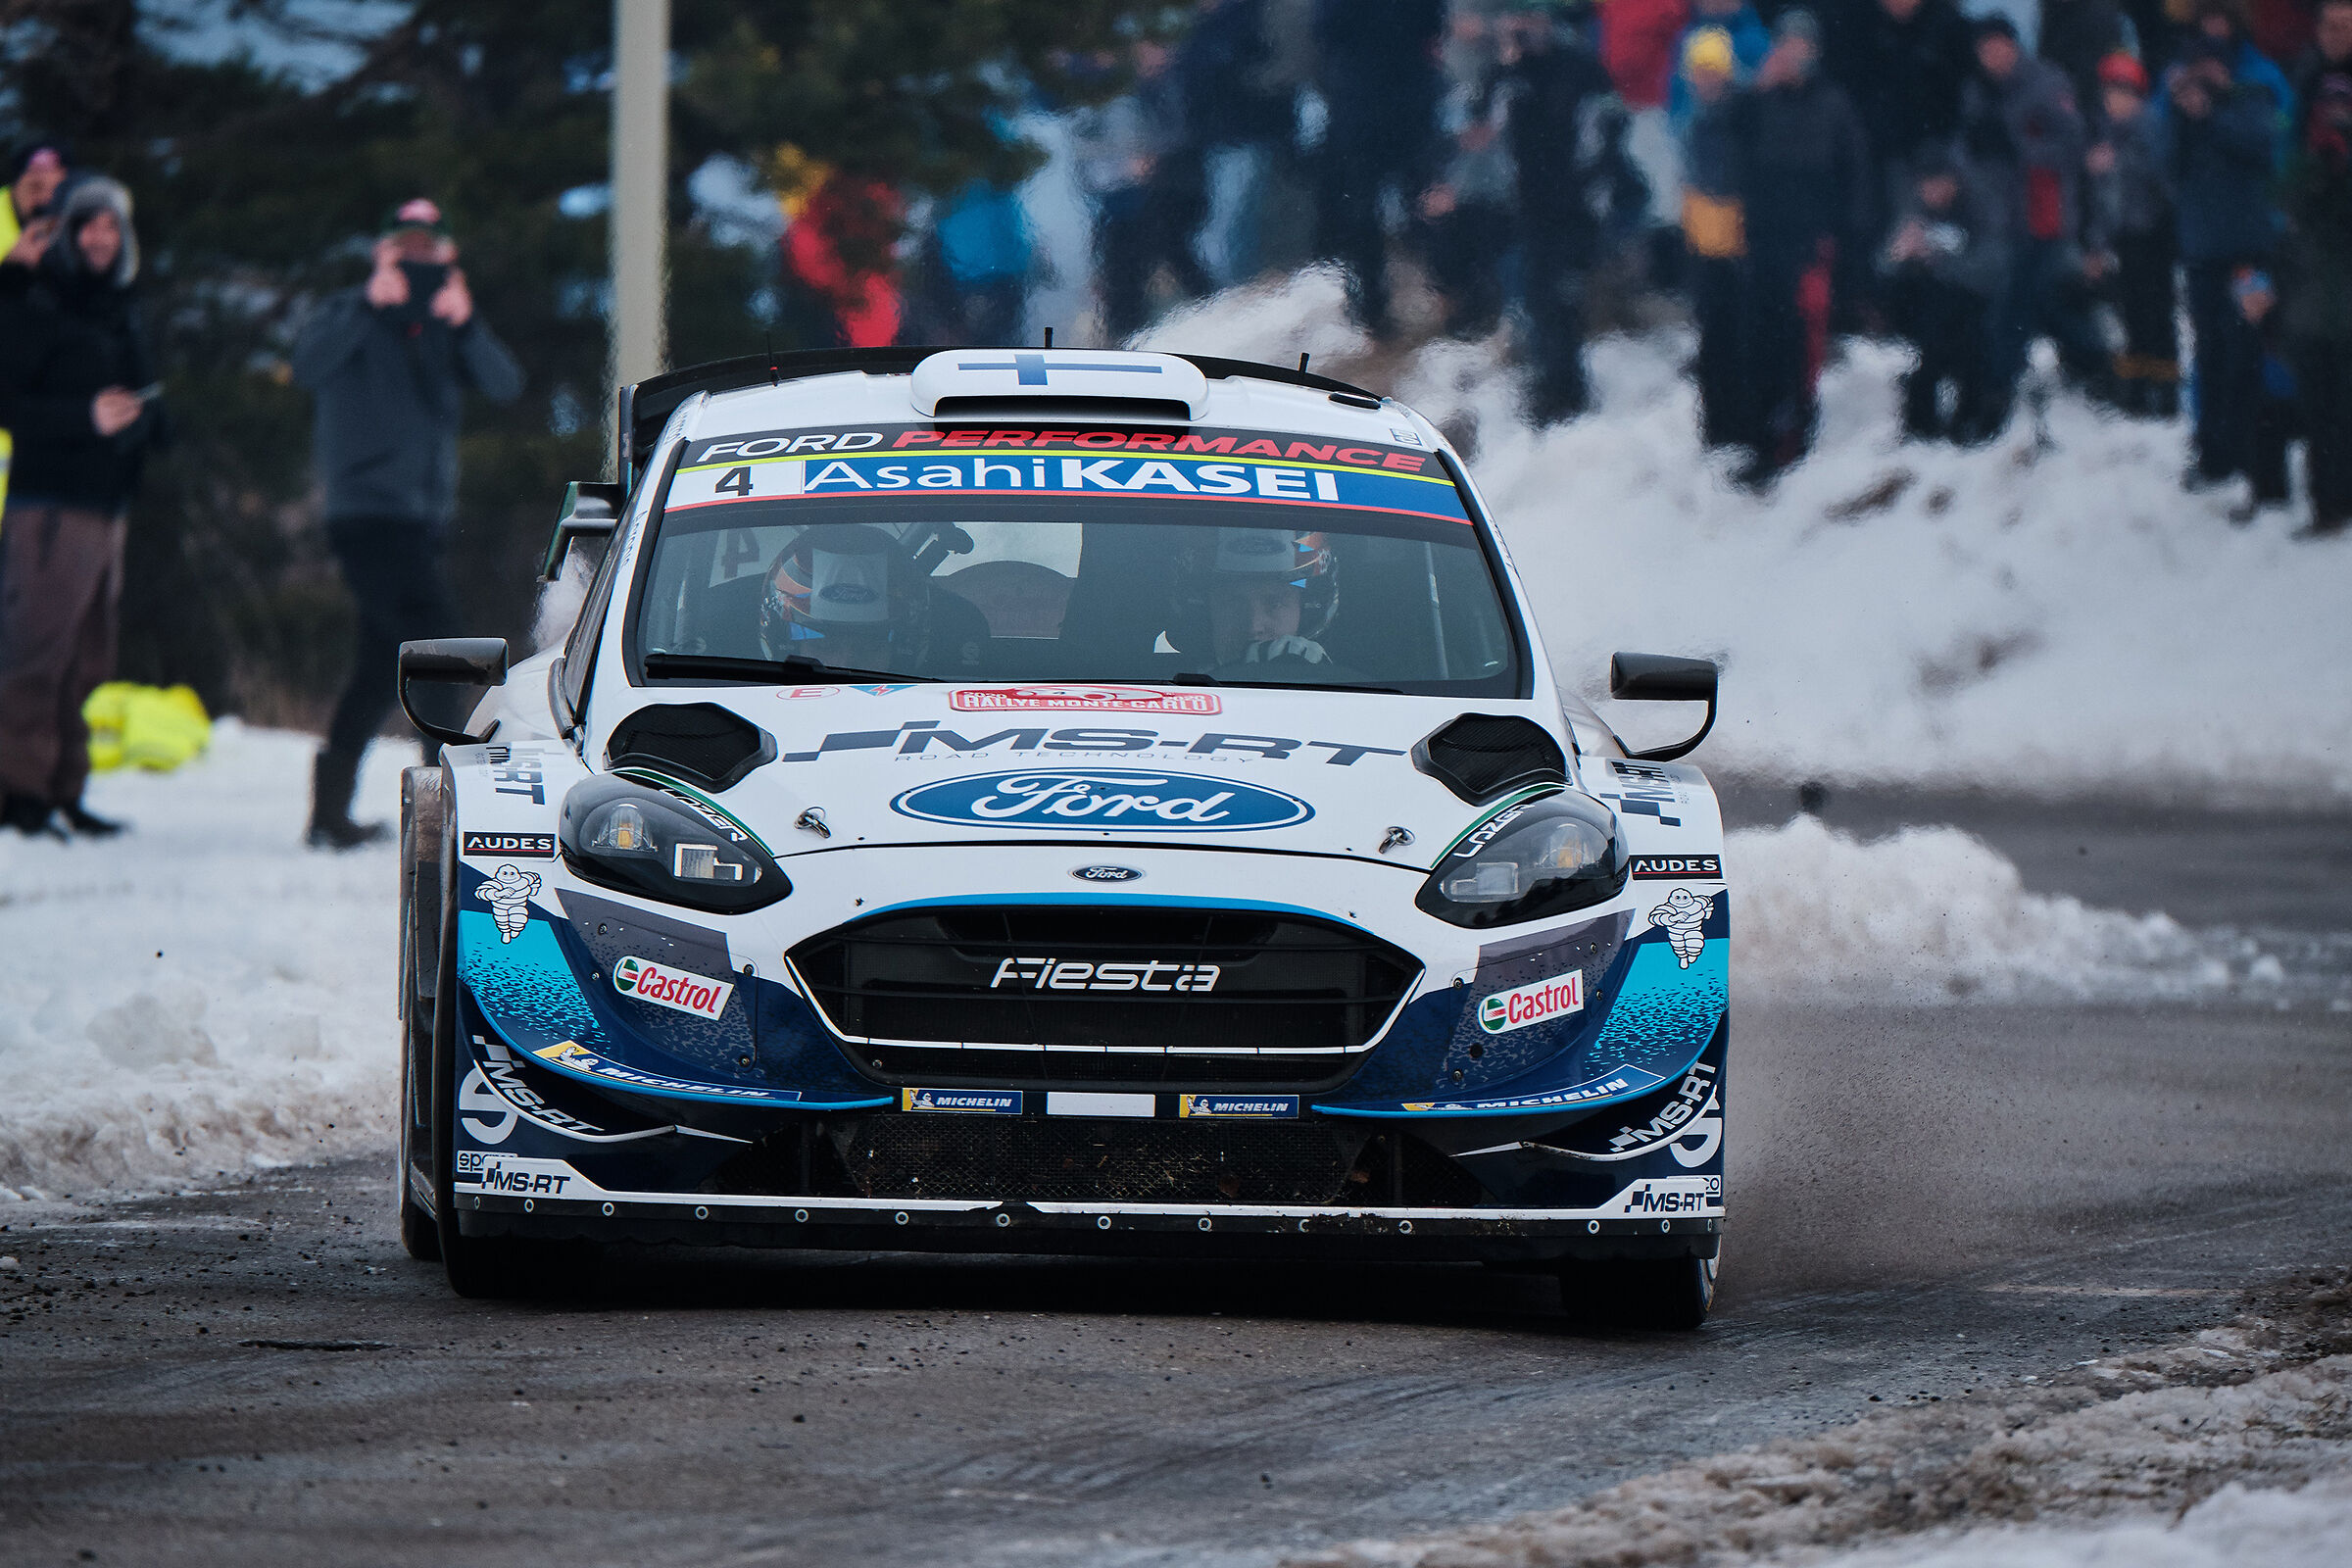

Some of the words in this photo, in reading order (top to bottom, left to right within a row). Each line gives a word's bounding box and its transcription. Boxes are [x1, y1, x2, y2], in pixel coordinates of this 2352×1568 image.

[696, 431, 884, 464] FORD
[892, 430, 1427, 472] PERFORMANCE
[713, 466, 754, 497] 4
[963, 695, 1041, 708] RALLYE
[1048, 697, 1208, 711] MONTE-CARLO
[895, 752, 990, 761] ROAD
[1017, 751, 1254, 763] TECHNOLOGY
[970, 774, 1236, 822] Ford
[466, 836, 553, 851] AUDES
[1085, 866, 1129, 879] Ford
[1634, 858, 1718, 872] AUDES
[636, 966, 722, 1013] Castrol
[990, 957, 1221, 992] Fiesta
[1508, 976, 1579, 1024] Castrol
[596, 1067, 769, 1097] MICHELIN
[1477, 1077, 1629, 1108] MICHELIN
[936, 1096, 1012, 1108] MICHELIN
[1213, 1102, 1290, 1113] MICHELIN
